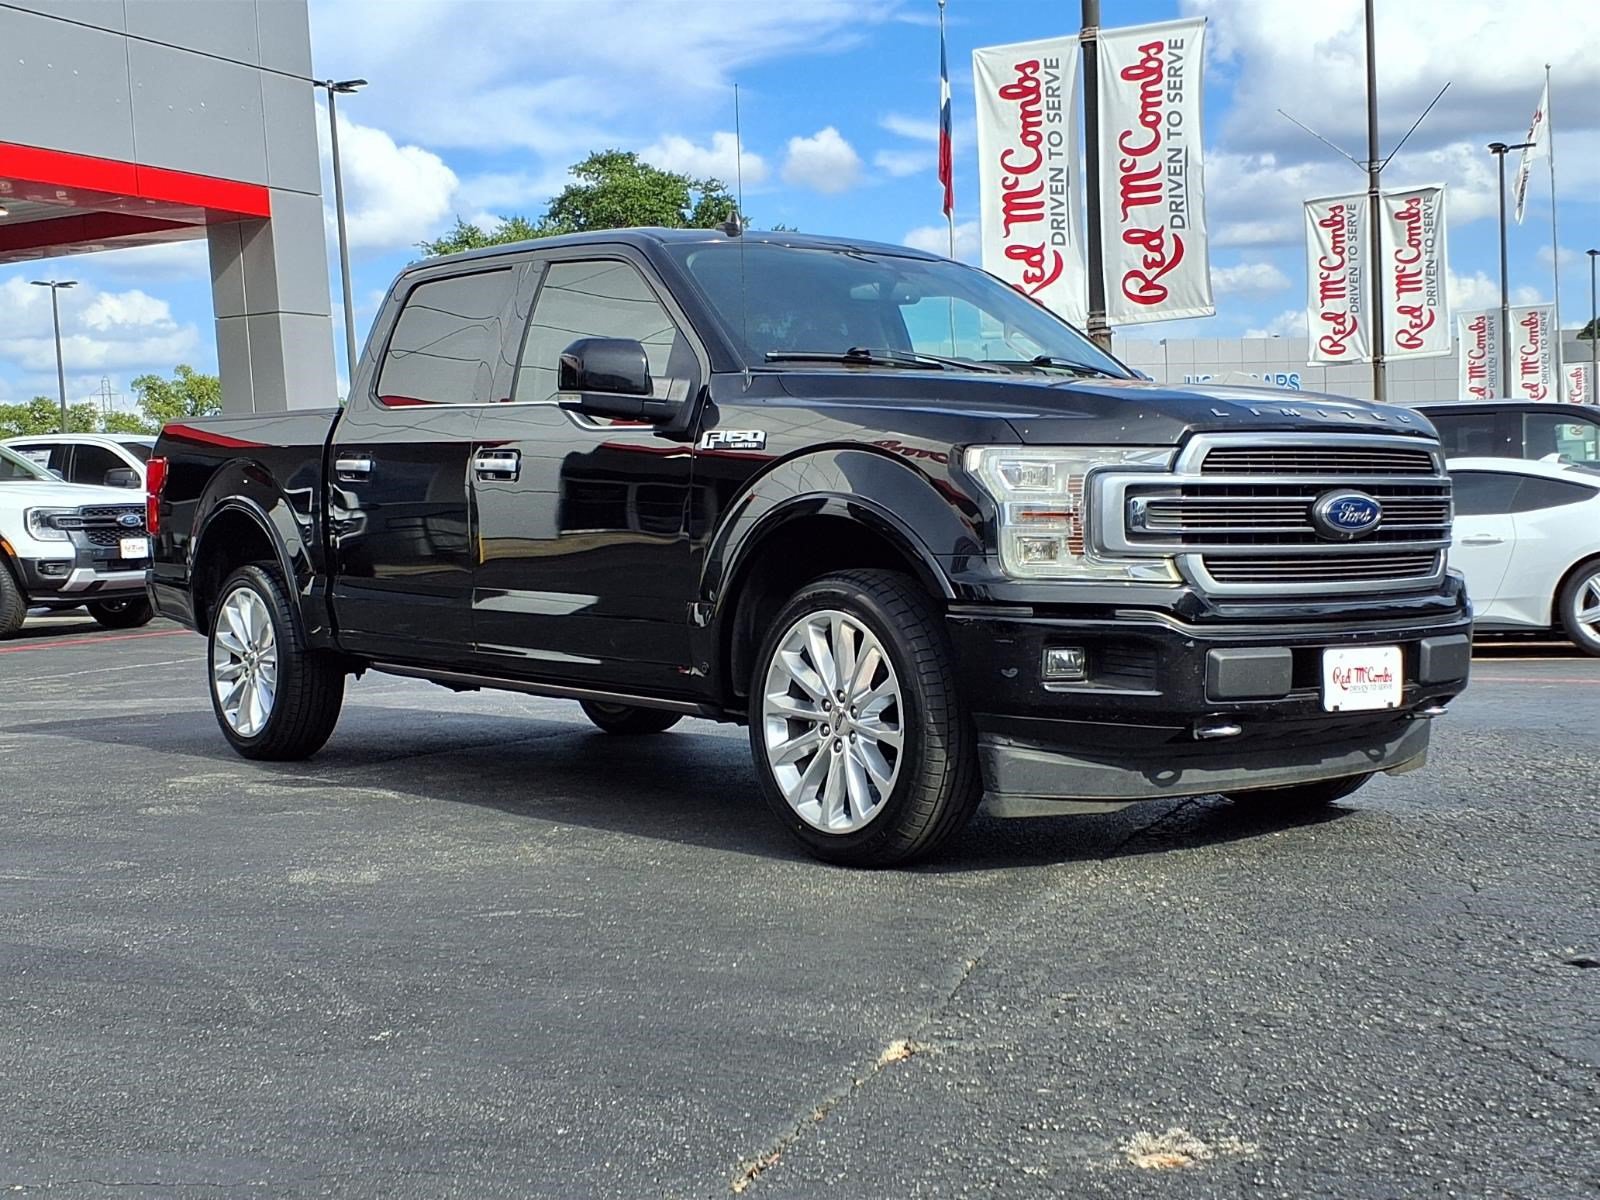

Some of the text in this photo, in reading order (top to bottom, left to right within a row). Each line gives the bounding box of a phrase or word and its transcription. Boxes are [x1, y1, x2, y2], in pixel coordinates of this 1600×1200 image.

[1043, 57, 1067, 247] DRIVEN TO SERVE
[1166, 37, 1186, 231] DRIVEN TO SERVE
[1122, 225, 1184, 306] Red
[1346, 203, 1360, 314] DRIVEN TO SERVE
[1423, 195, 1437, 307] DRIVEN TO SERVE
[1318, 310, 1358, 356] Red
[1394, 303, 1435, 350] Red
[1487, 315, 1496, 389] DRIVEN TO SERVE
[1338, 501, 1372, 523] Ford
[1332, 666, 1352, 691] Red
